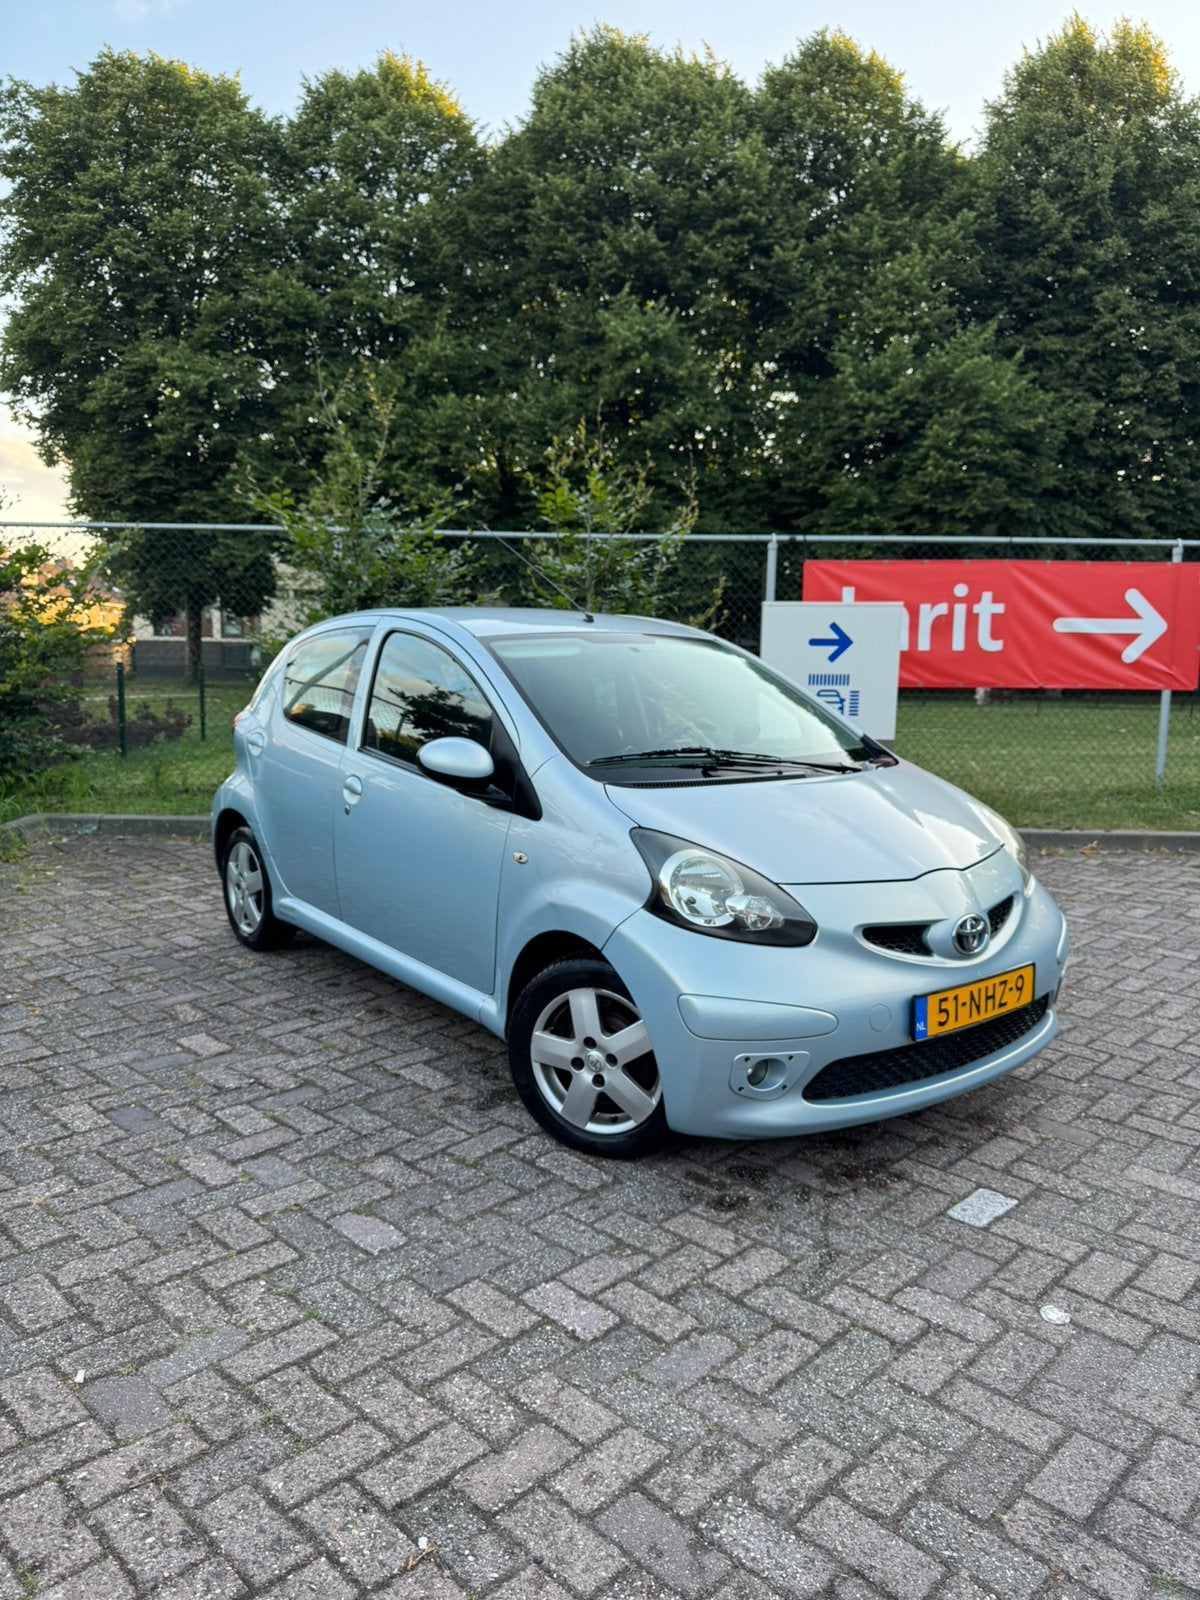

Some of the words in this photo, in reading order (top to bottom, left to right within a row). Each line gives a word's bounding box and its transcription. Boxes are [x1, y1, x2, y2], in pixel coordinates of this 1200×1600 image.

[841, 583, 1005, 652] rit
[937, 974, 1025, 1026] 51-NHZ-9
[916, 1021, 926, 1032] NL
